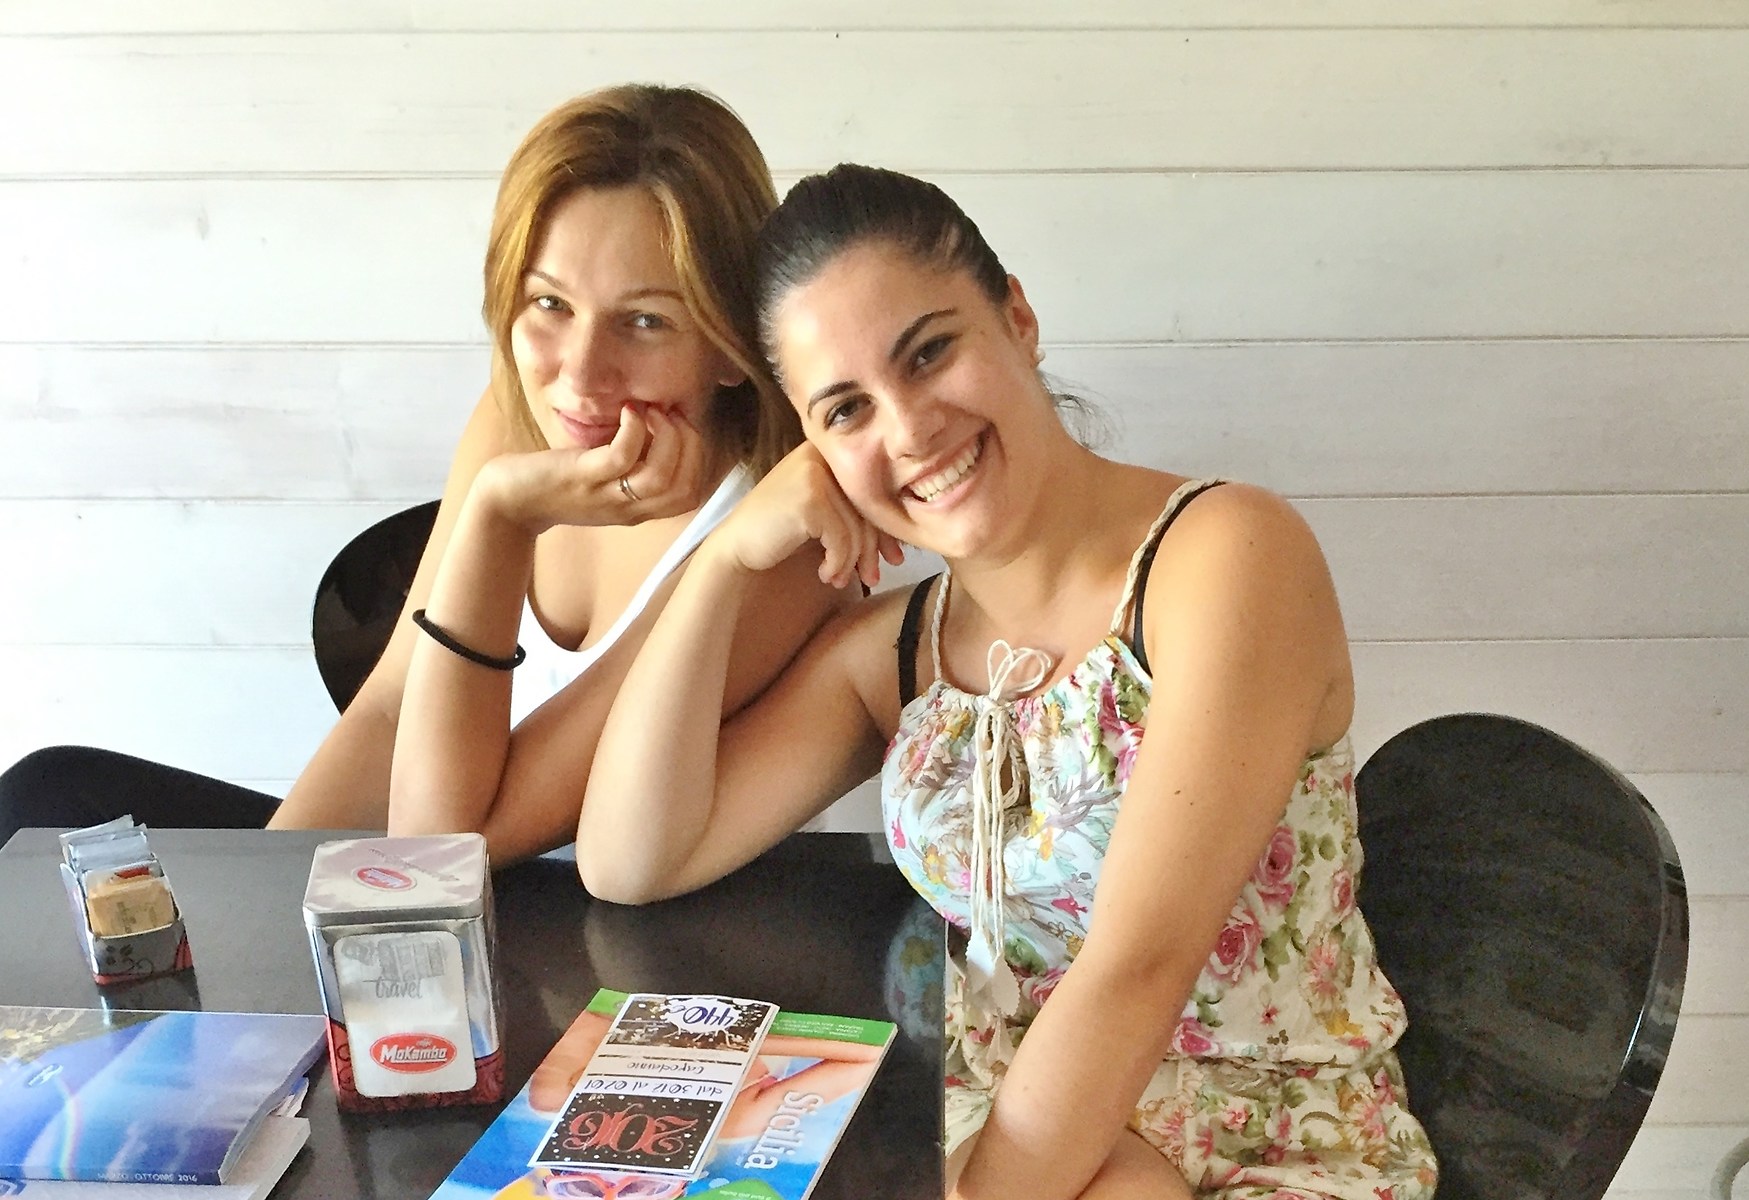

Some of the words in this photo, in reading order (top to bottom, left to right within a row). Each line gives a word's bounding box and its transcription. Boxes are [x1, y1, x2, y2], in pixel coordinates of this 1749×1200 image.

[632, 1081, 649, 1091] al
[696, 1086, 723, 1097] dal
[562, 1103, 699, 1155] 2016
[743, 1091, 825, 1170] Sicilia
[178, 1174, 198, 1183] 2016
